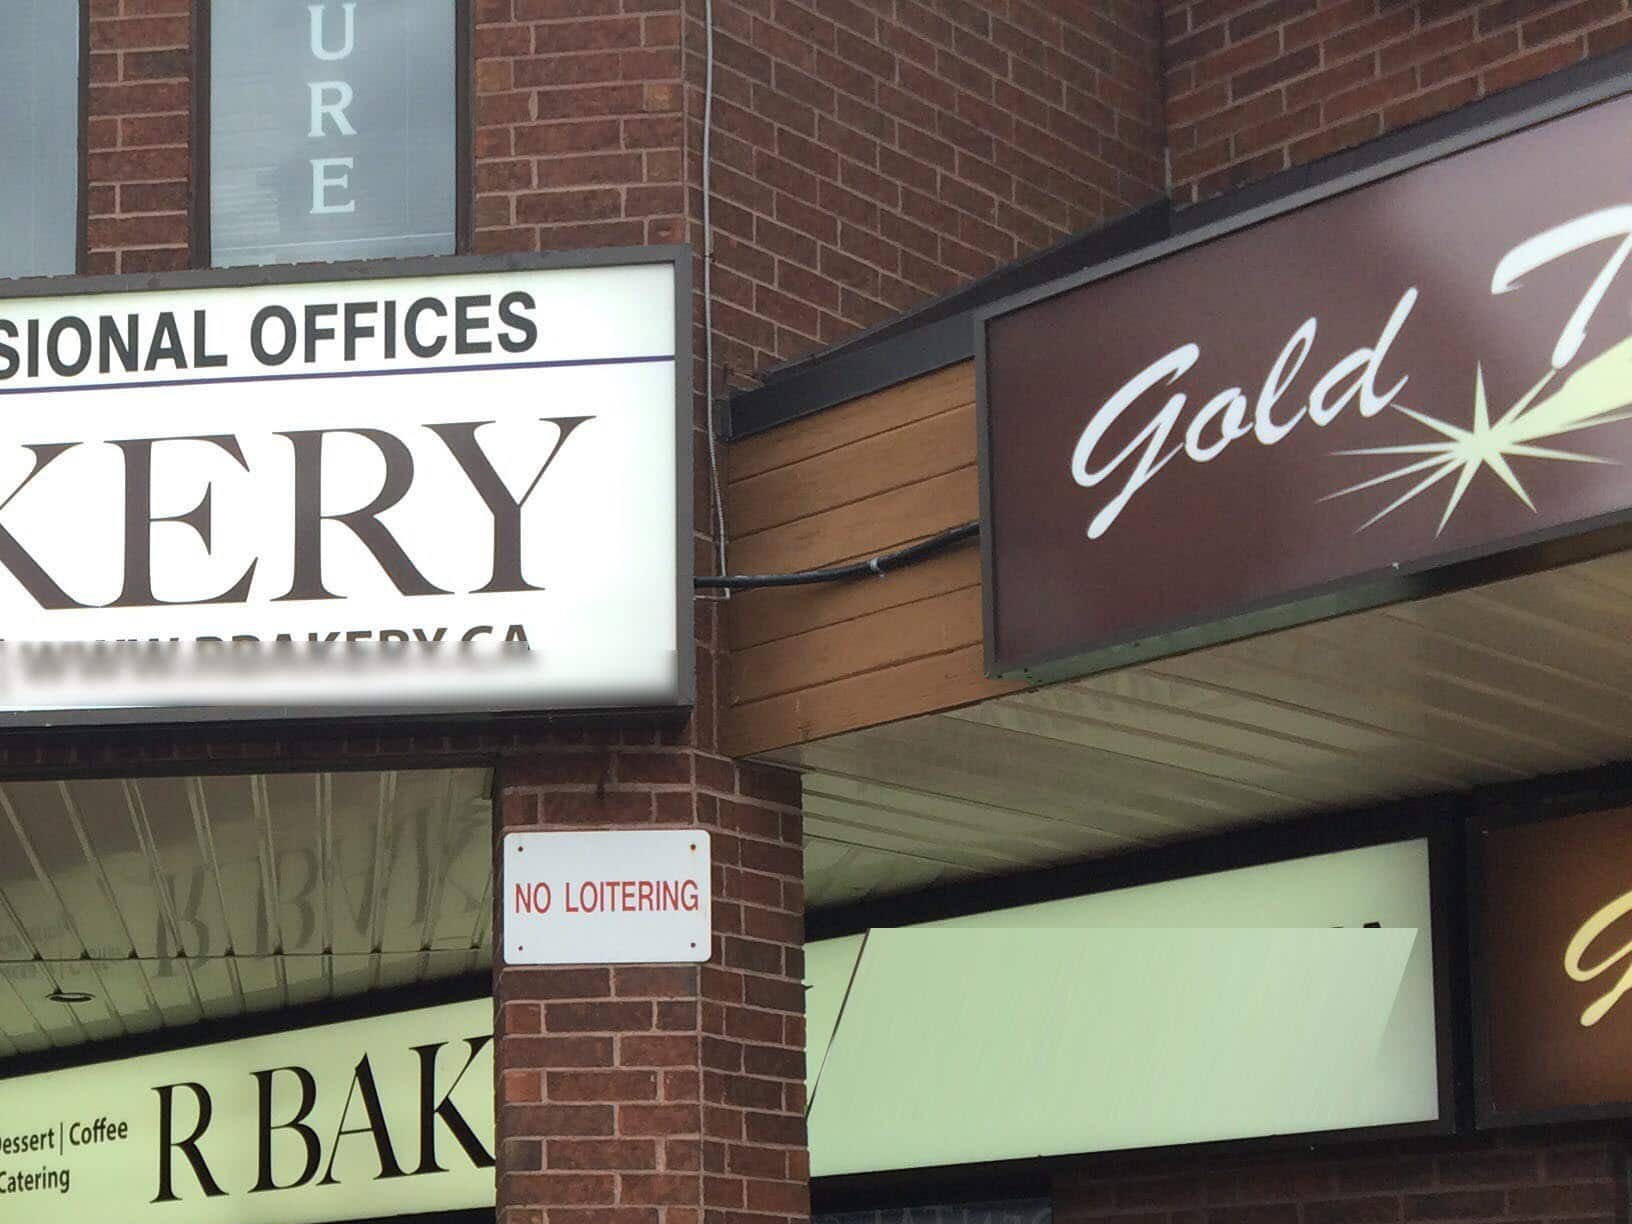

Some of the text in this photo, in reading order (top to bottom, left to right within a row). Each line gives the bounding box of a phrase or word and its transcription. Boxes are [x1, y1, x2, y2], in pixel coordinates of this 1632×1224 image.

[249, 291, 538, 367] OFFICES
[1071, 287, 1418, 541] Gold
[515, 879, 699, 914] NO LOITERING
[69, 1117, 128, 1146] Coffee
[149, 1034, 497, 1203] R BAK
